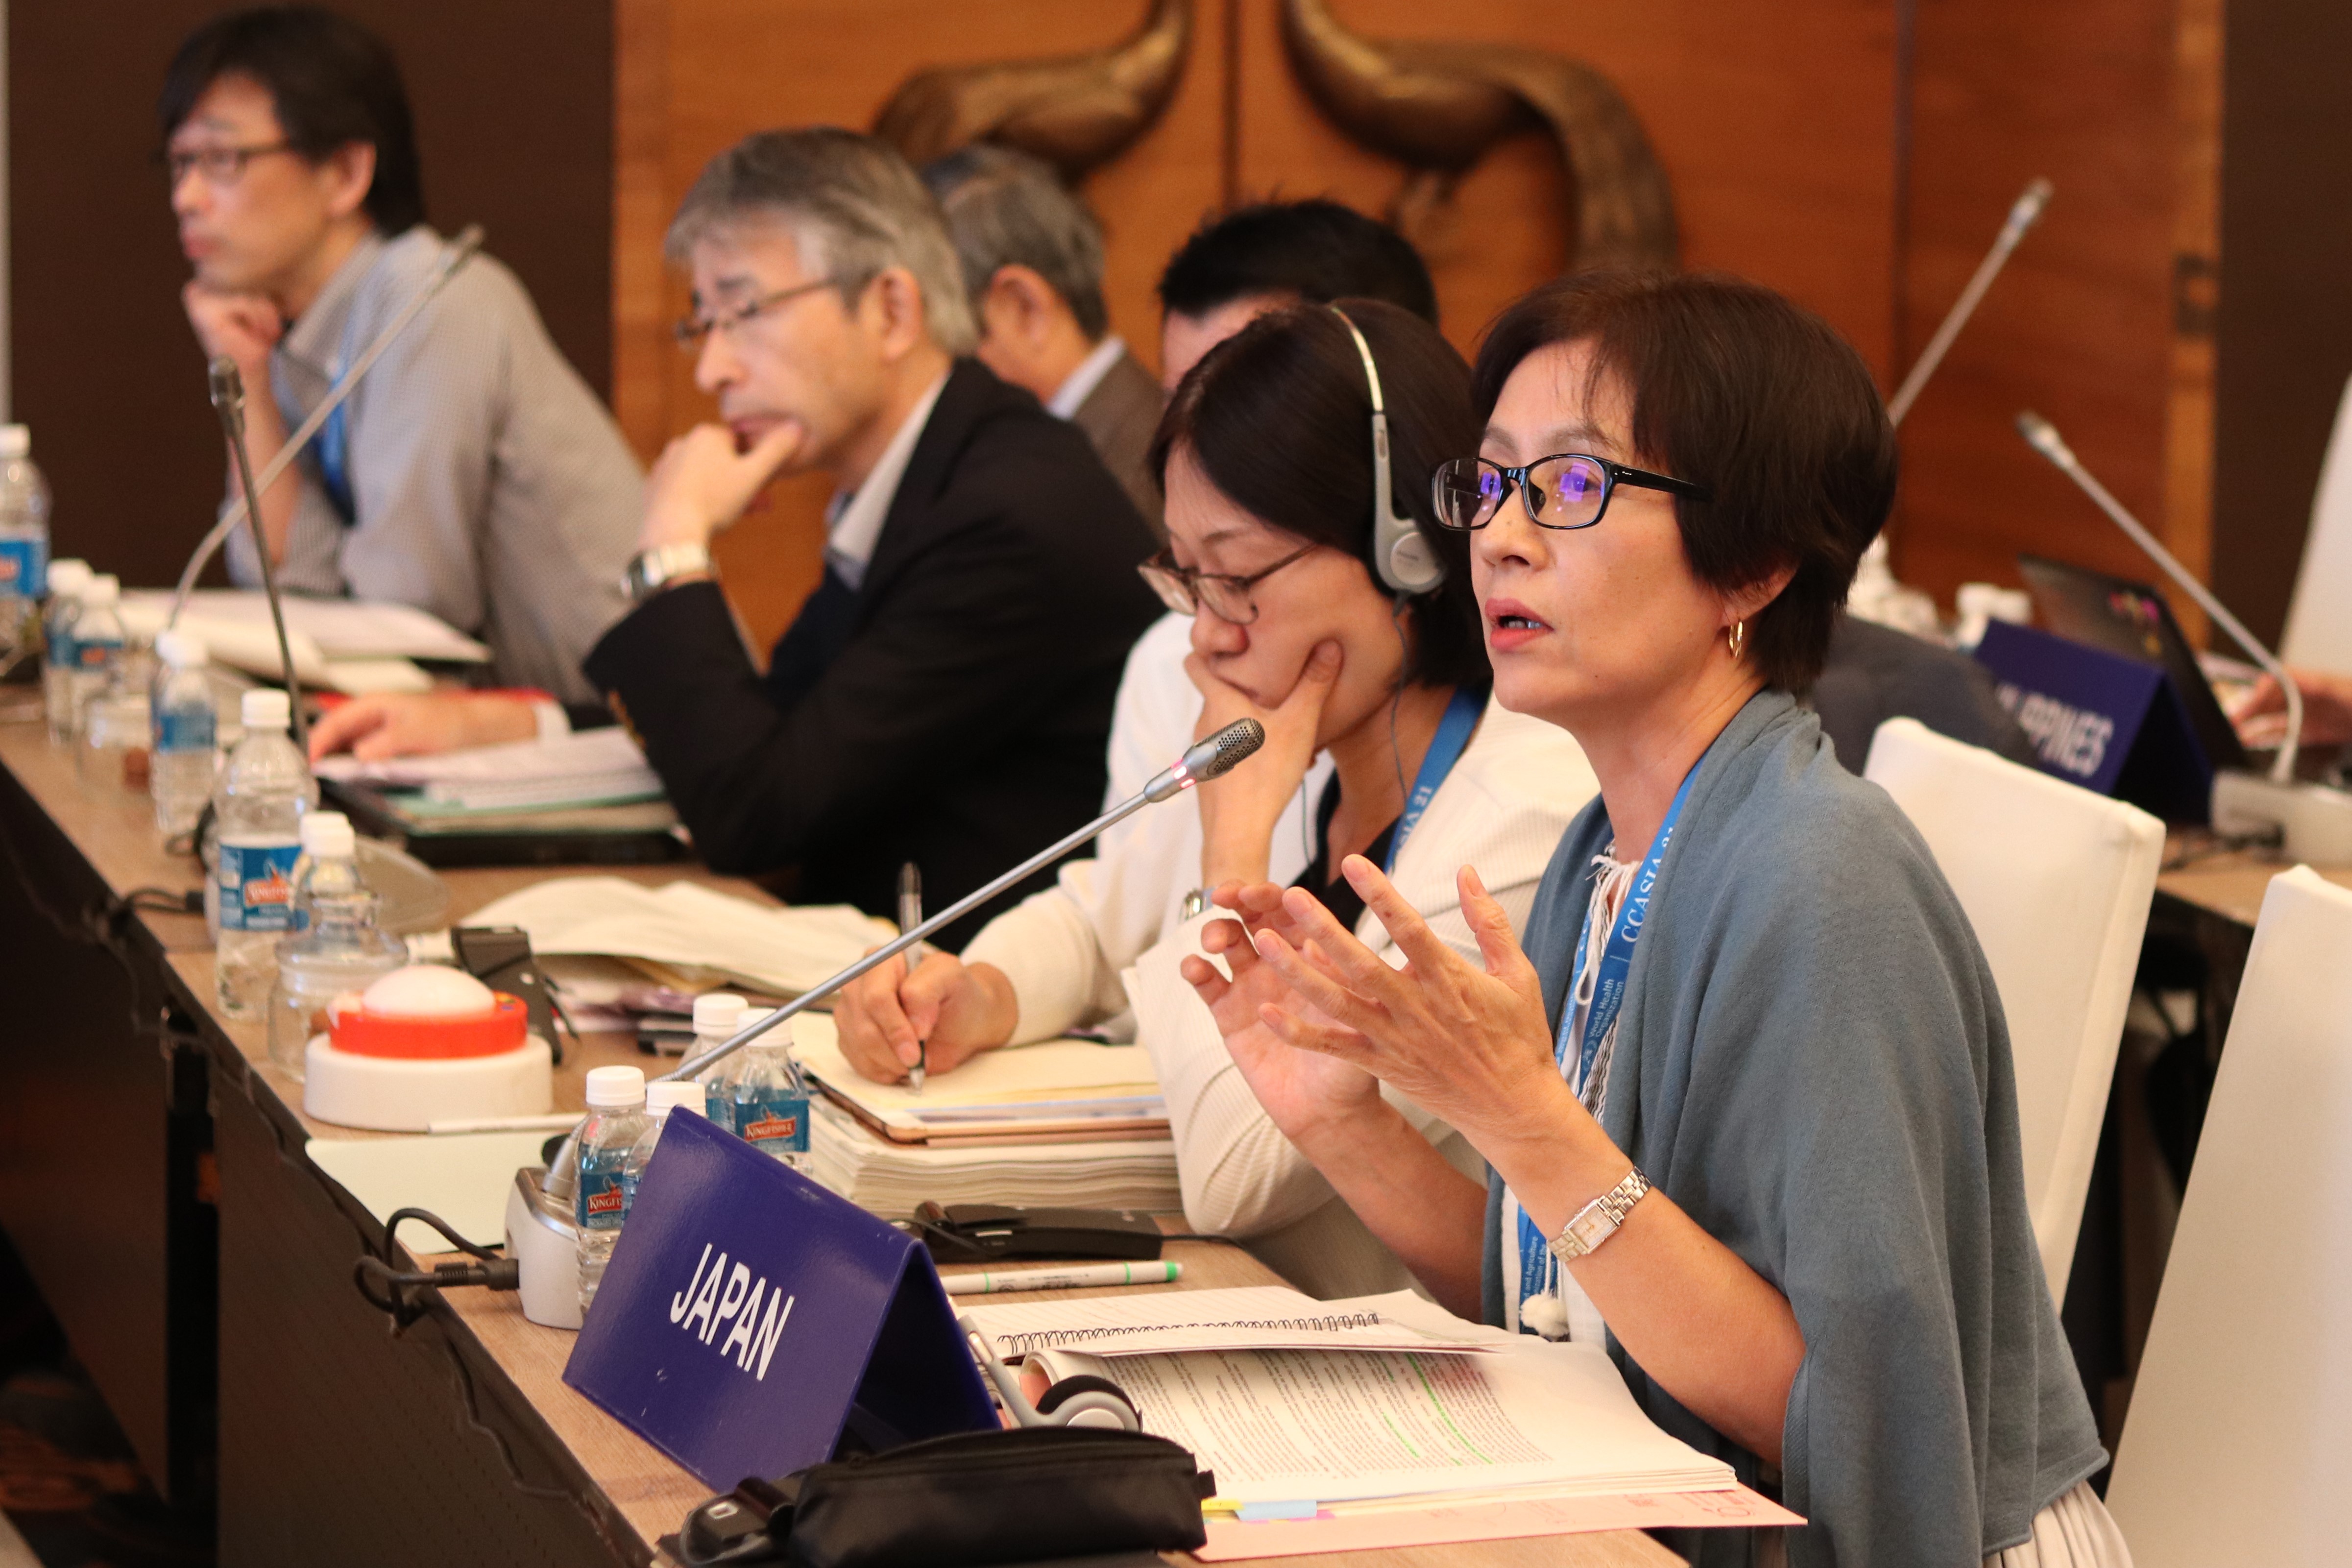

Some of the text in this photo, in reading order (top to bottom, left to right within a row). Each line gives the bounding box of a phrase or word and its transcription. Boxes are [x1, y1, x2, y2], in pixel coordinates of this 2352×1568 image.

[1589, 979, 1614, 1038] World Health
[1596, 981, 1624, 1037] Organization
[670, 1242, 795, 1381] JAPAN
